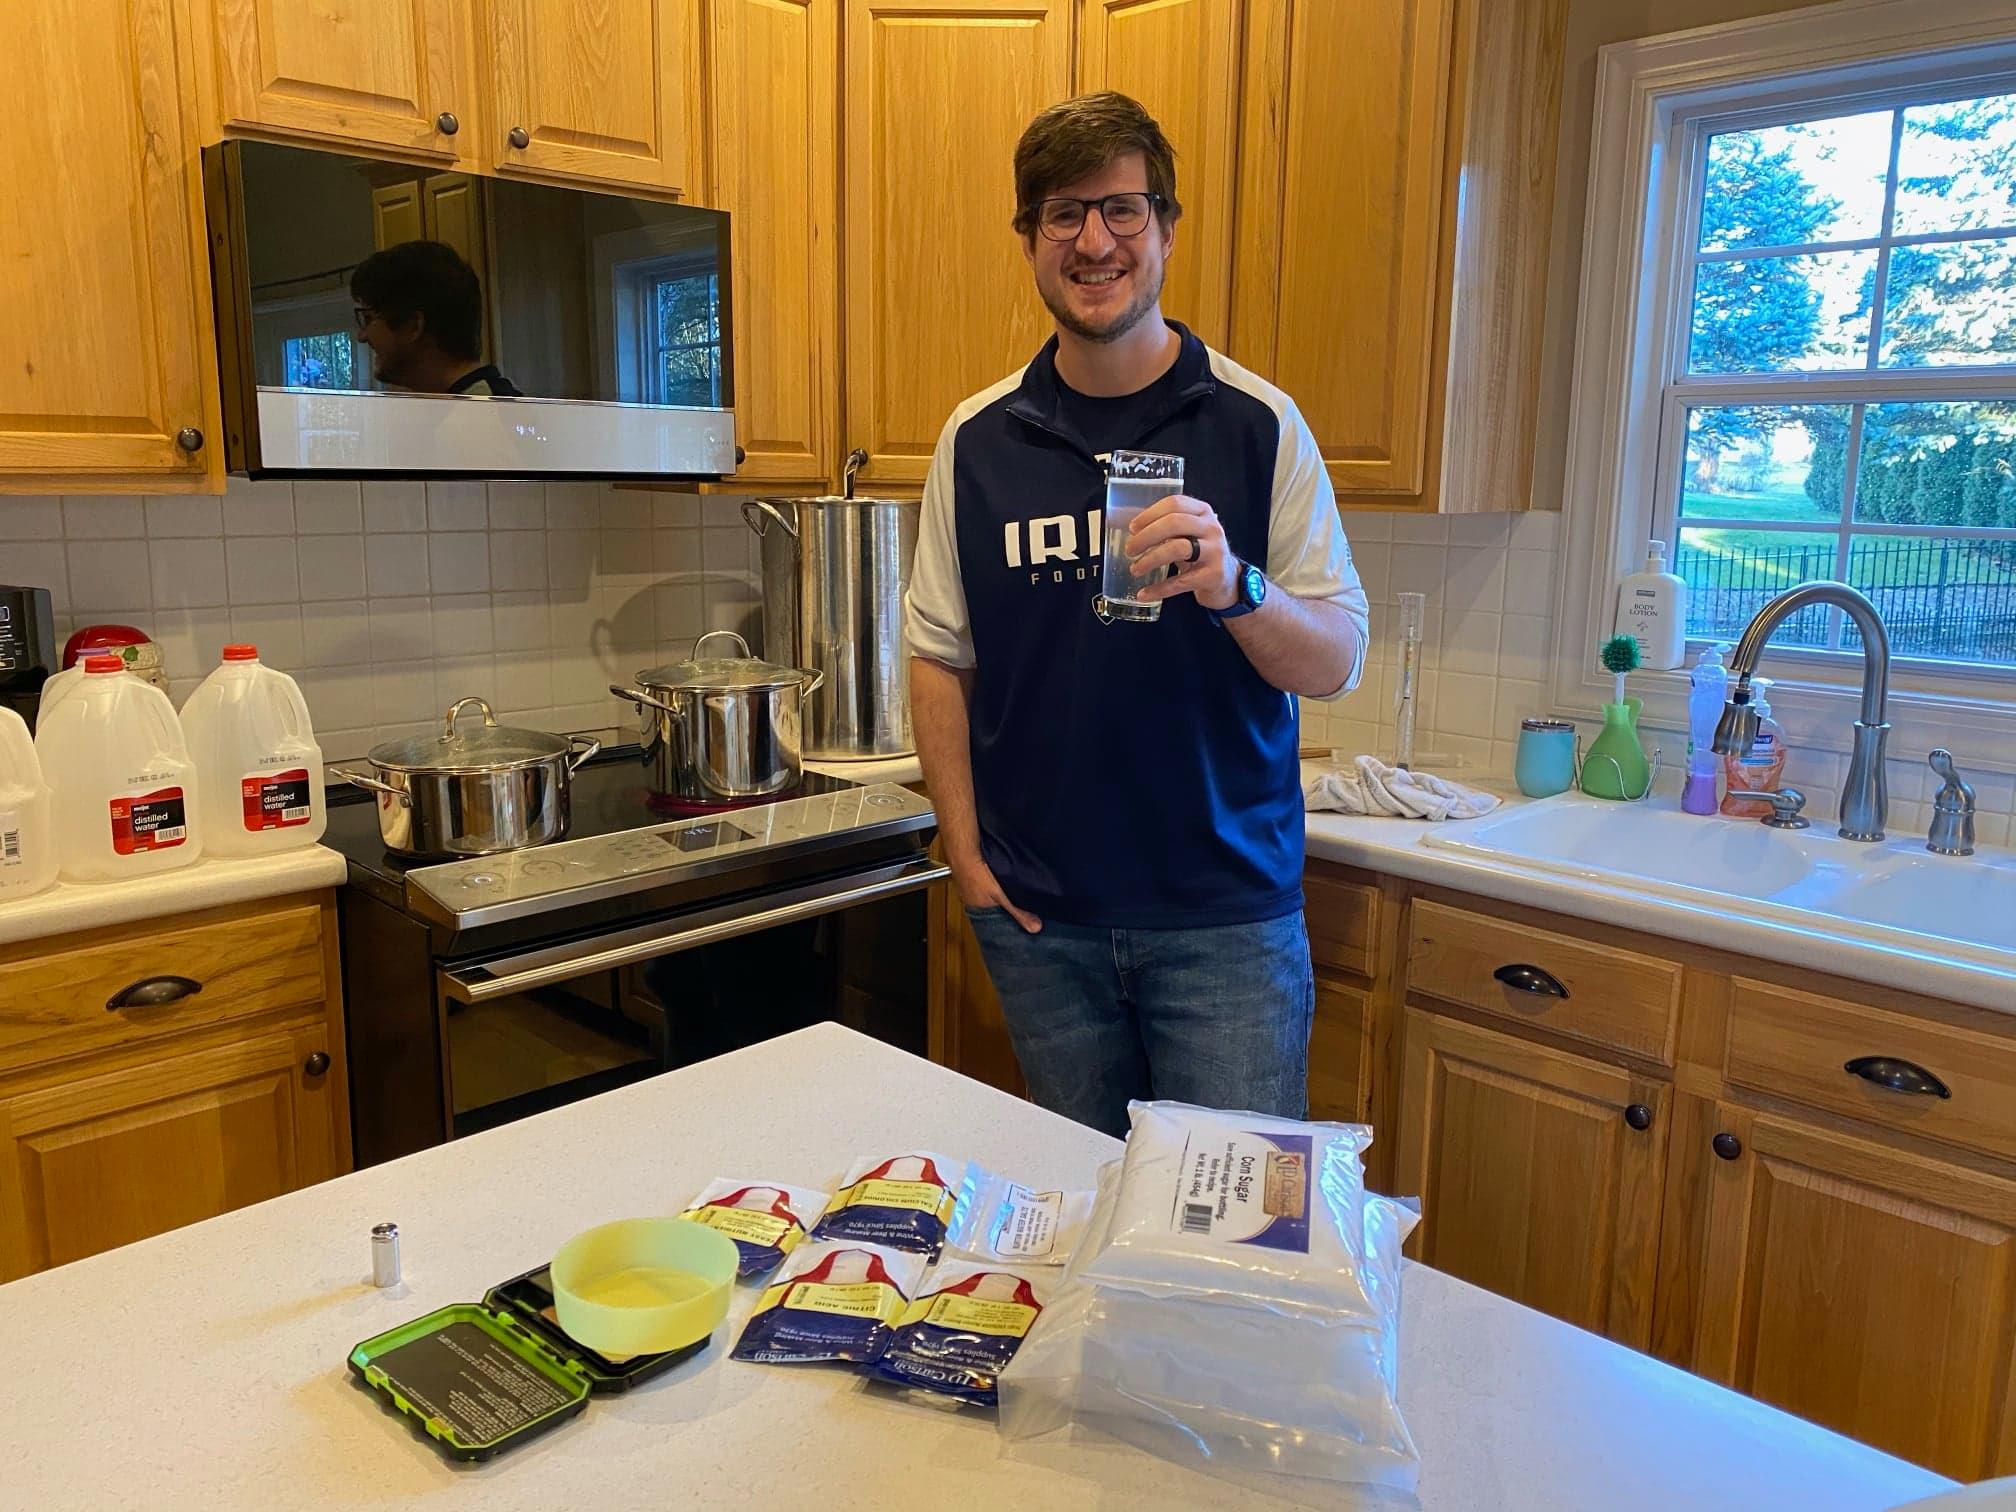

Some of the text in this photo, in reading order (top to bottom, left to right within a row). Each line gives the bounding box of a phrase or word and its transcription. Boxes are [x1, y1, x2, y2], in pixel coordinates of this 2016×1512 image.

[1004, 509, 1103, 568] IRI
[1031, 566, 1100, 586] FOOT
[264, 793, 295, 803] distilled
[264, 802, 286, 810] water
[134, 812, 168, 825] distilled
[135, 822, 159, 832] water
[1234, 1156, 1255, 1203] Corn Sugar
[885, 1223, 914, 1231] Supplies
[813, 1301, 876, 1313] CITRIC ACID
[963, 1347, 996, 1360] Supplies
[894, 1360, 945, 1381] Carlson
